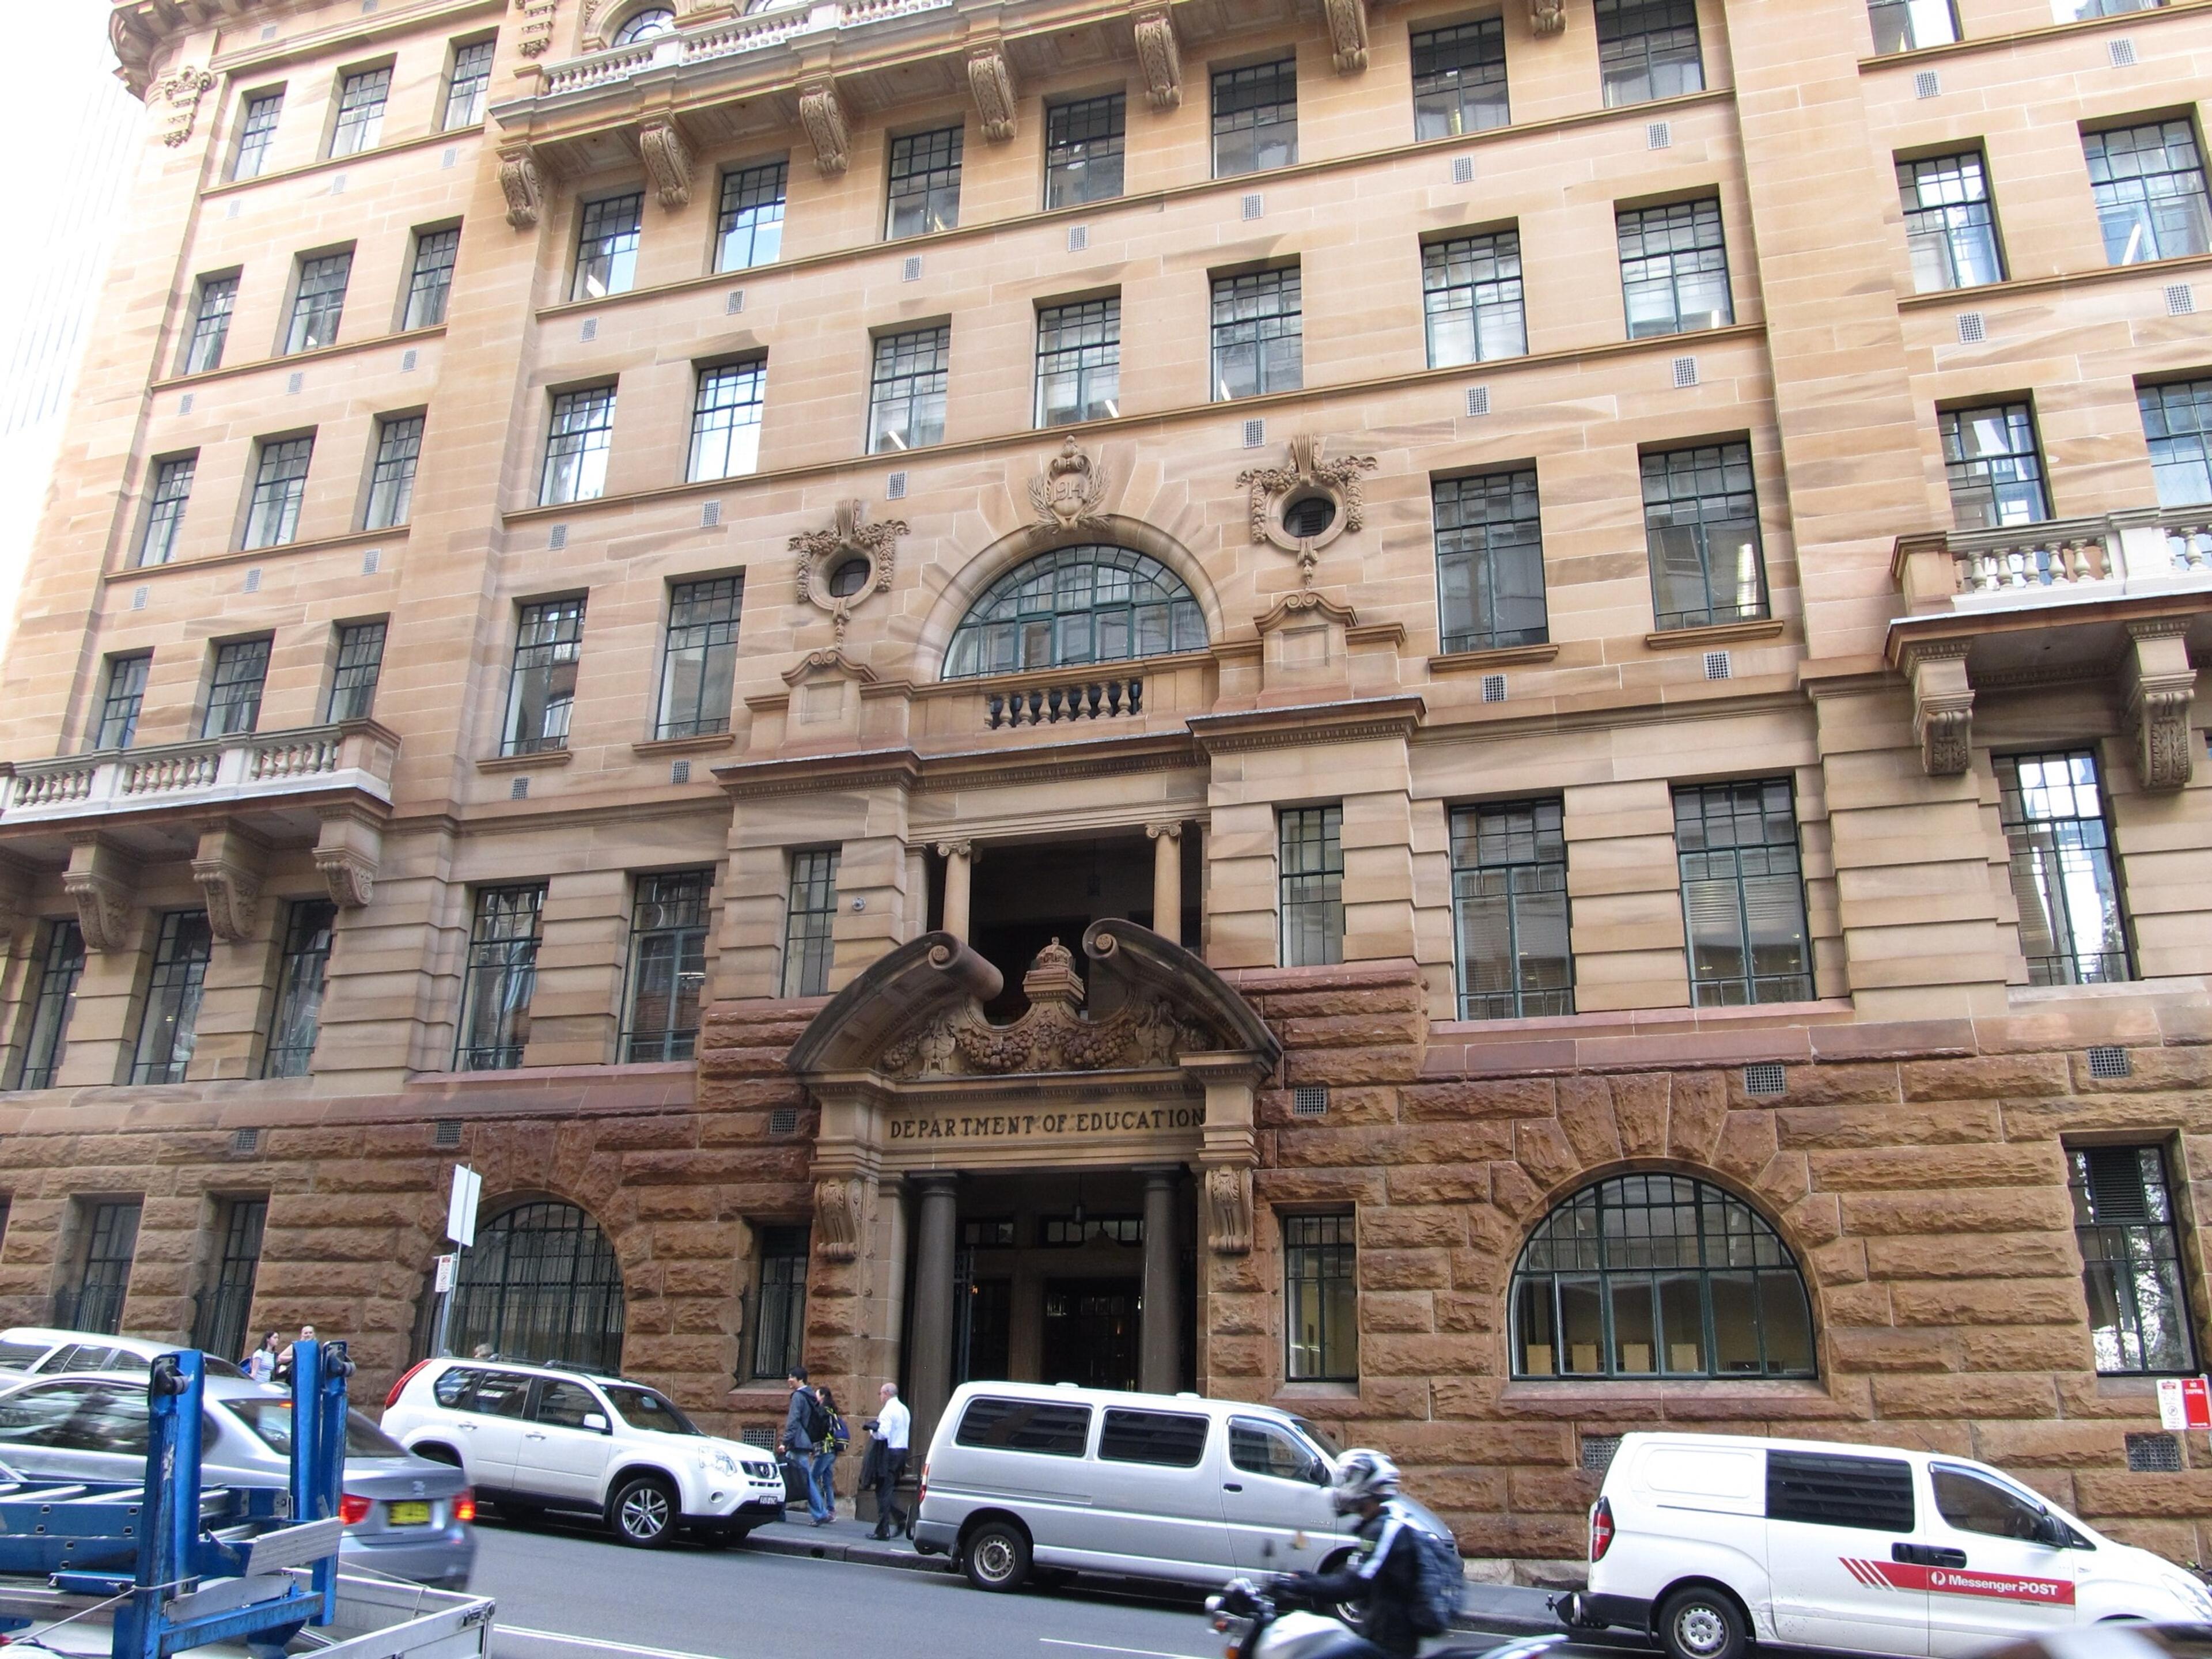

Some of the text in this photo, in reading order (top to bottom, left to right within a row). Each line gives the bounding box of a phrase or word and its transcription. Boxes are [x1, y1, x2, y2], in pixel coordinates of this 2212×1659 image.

[1051, 481, 1084, 500] 1914
[891, 1108, 1205, 1138] DEPARTMENT OF EDUCATION
